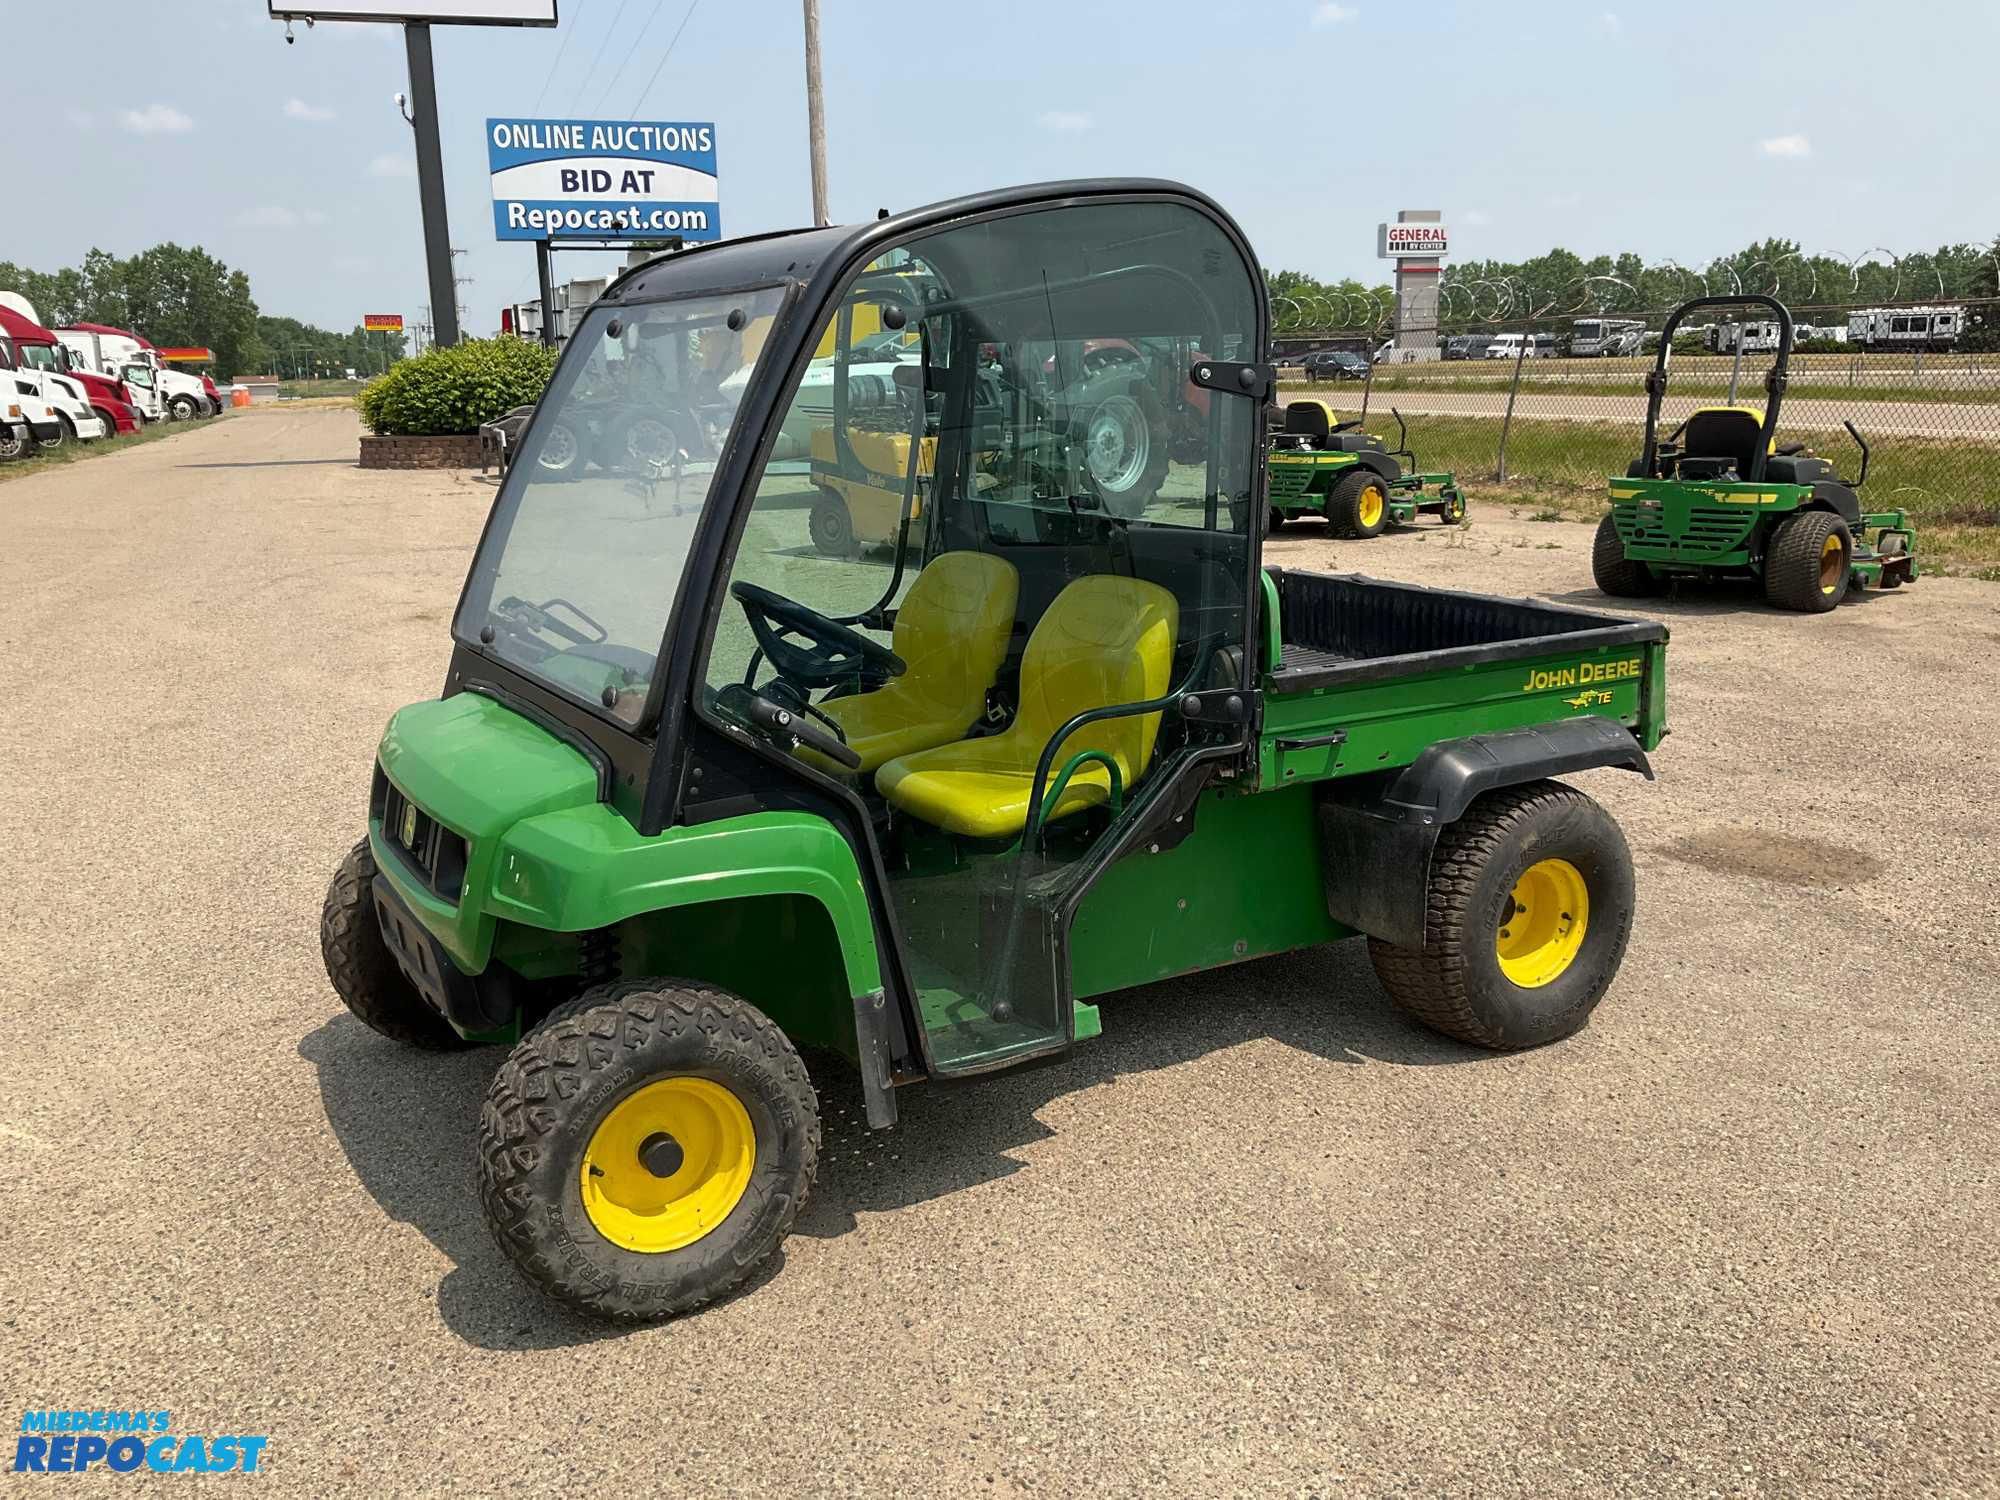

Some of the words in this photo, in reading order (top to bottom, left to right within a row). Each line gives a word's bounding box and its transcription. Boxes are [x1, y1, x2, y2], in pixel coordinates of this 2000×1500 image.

[493, 124, 585, 150] ONLINE
[591, 126, 712, 152] AUCTIONS
[561, 169, 612, 193] BID
[620, 170, 655, 193] AT
[508, 203, 708, 234] Repocast.com
[1389, 229, 1447, 241] GENERAL
[1409, 242, 1419, 250] RV
[1419, 242, 1444, 250] CENTER
[1523, 669, 1575, 691] JOHN
[1580, 659, 1641, 684] DEERE
[1597, 691, 1613, 704] TE
[703, 1046, 797, 1130] CARLISLE
